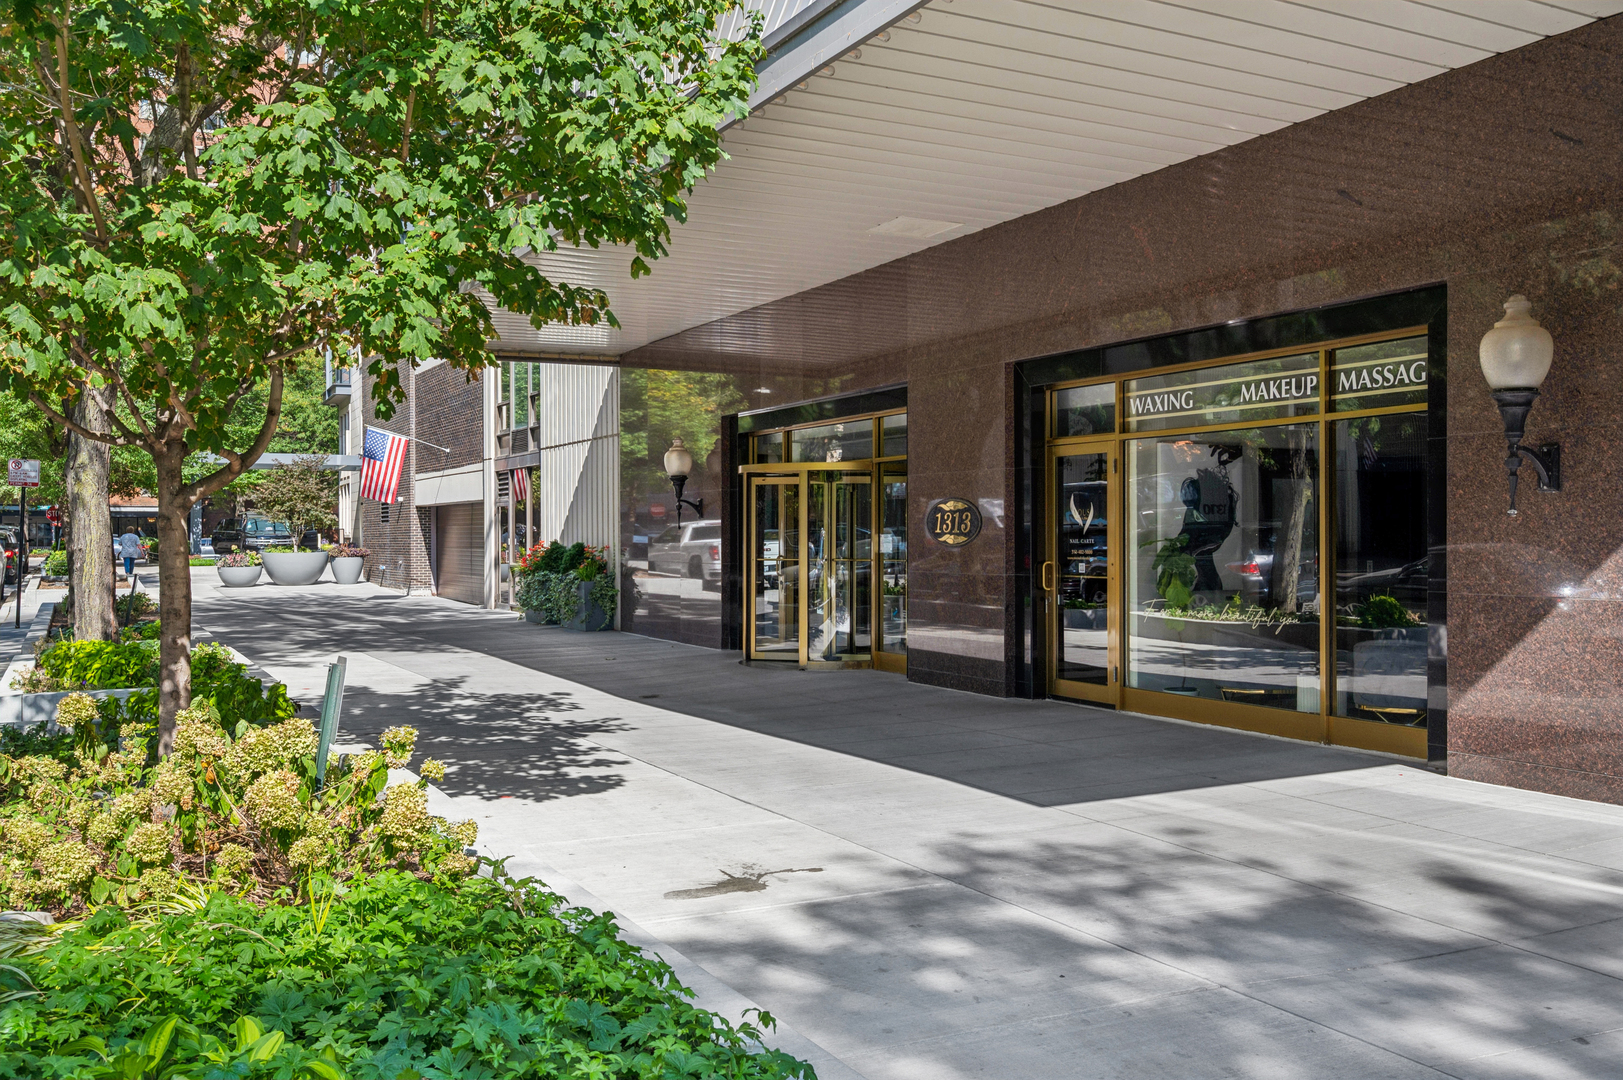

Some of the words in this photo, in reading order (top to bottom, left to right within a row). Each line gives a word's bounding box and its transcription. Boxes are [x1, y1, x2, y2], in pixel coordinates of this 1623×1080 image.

[1240, 375, 1318, 402] MAKEUP
[1338, 360, 1427, 392] MASSAG
[1130, 390, 1194, 415] WAXING
[935, 512, 971, 533] 1313
[1187, 609, 1216, 619] more
[1219, 603, 1278, 630] beautiful
[1275, 616, 1301, 635] you
